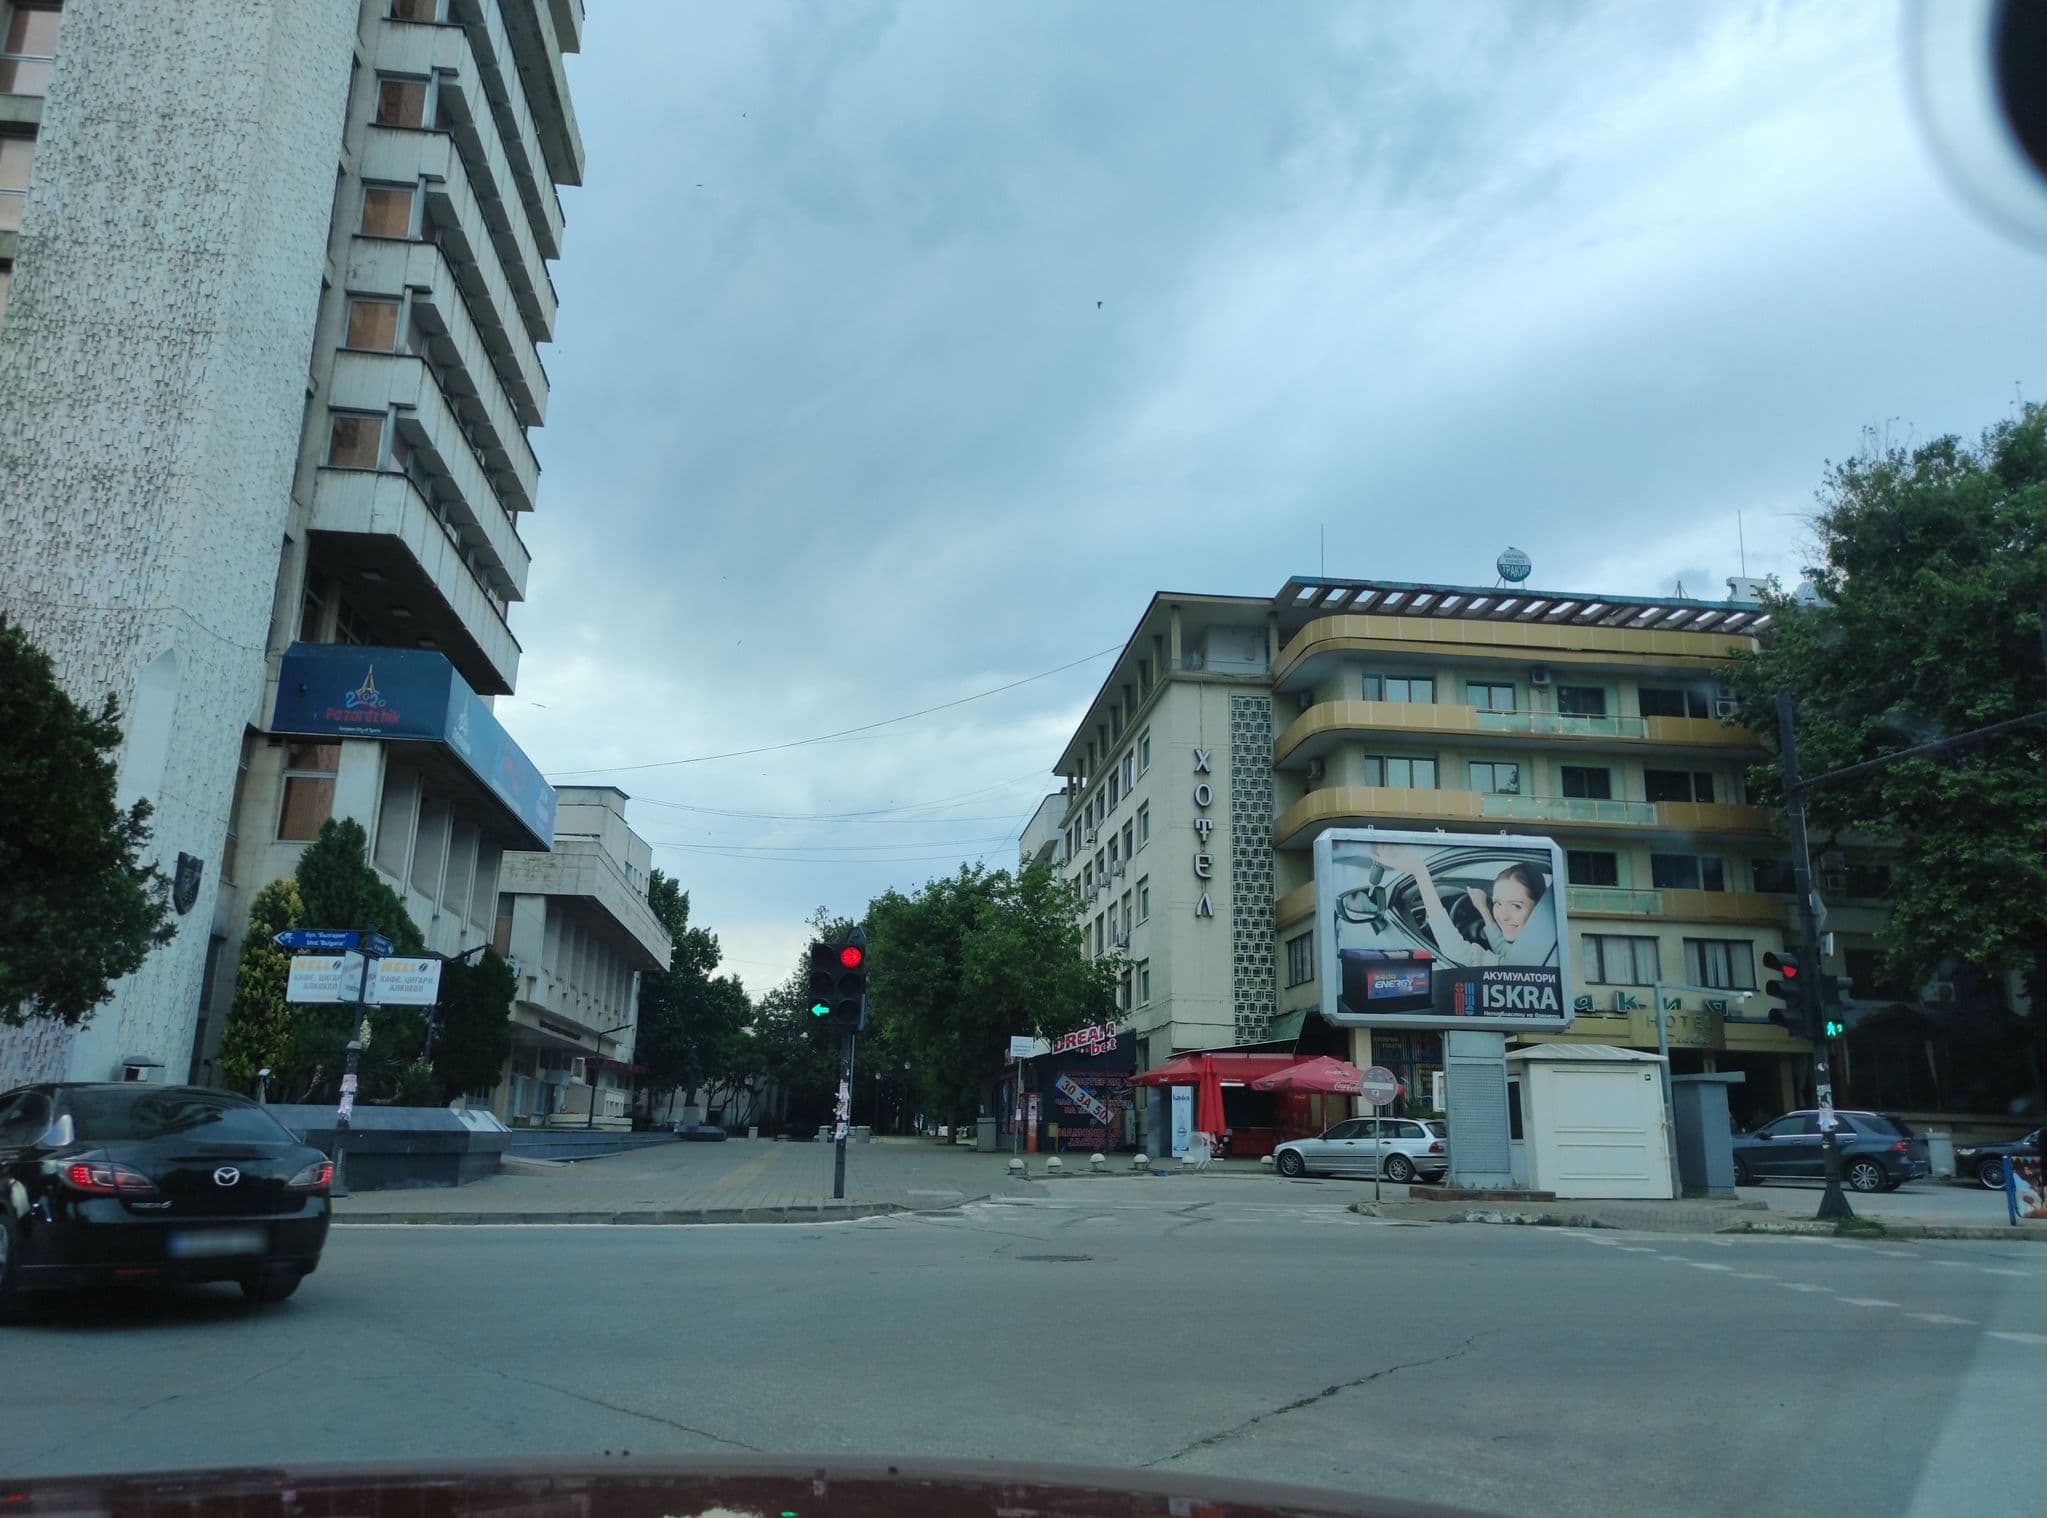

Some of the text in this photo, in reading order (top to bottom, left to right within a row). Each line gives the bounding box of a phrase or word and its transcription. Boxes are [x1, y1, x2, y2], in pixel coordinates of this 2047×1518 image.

[1194, 749, 1214, 918] ХОТЕЛ
[1374, 976, 1414, 989] ENERGY
[1482, 970, 1556, 984] АКУМУЛАТОРИ
[1482, 984, 1559, 1010] ISKRA
[1052, 1021, 1117, 1055] DREAM
